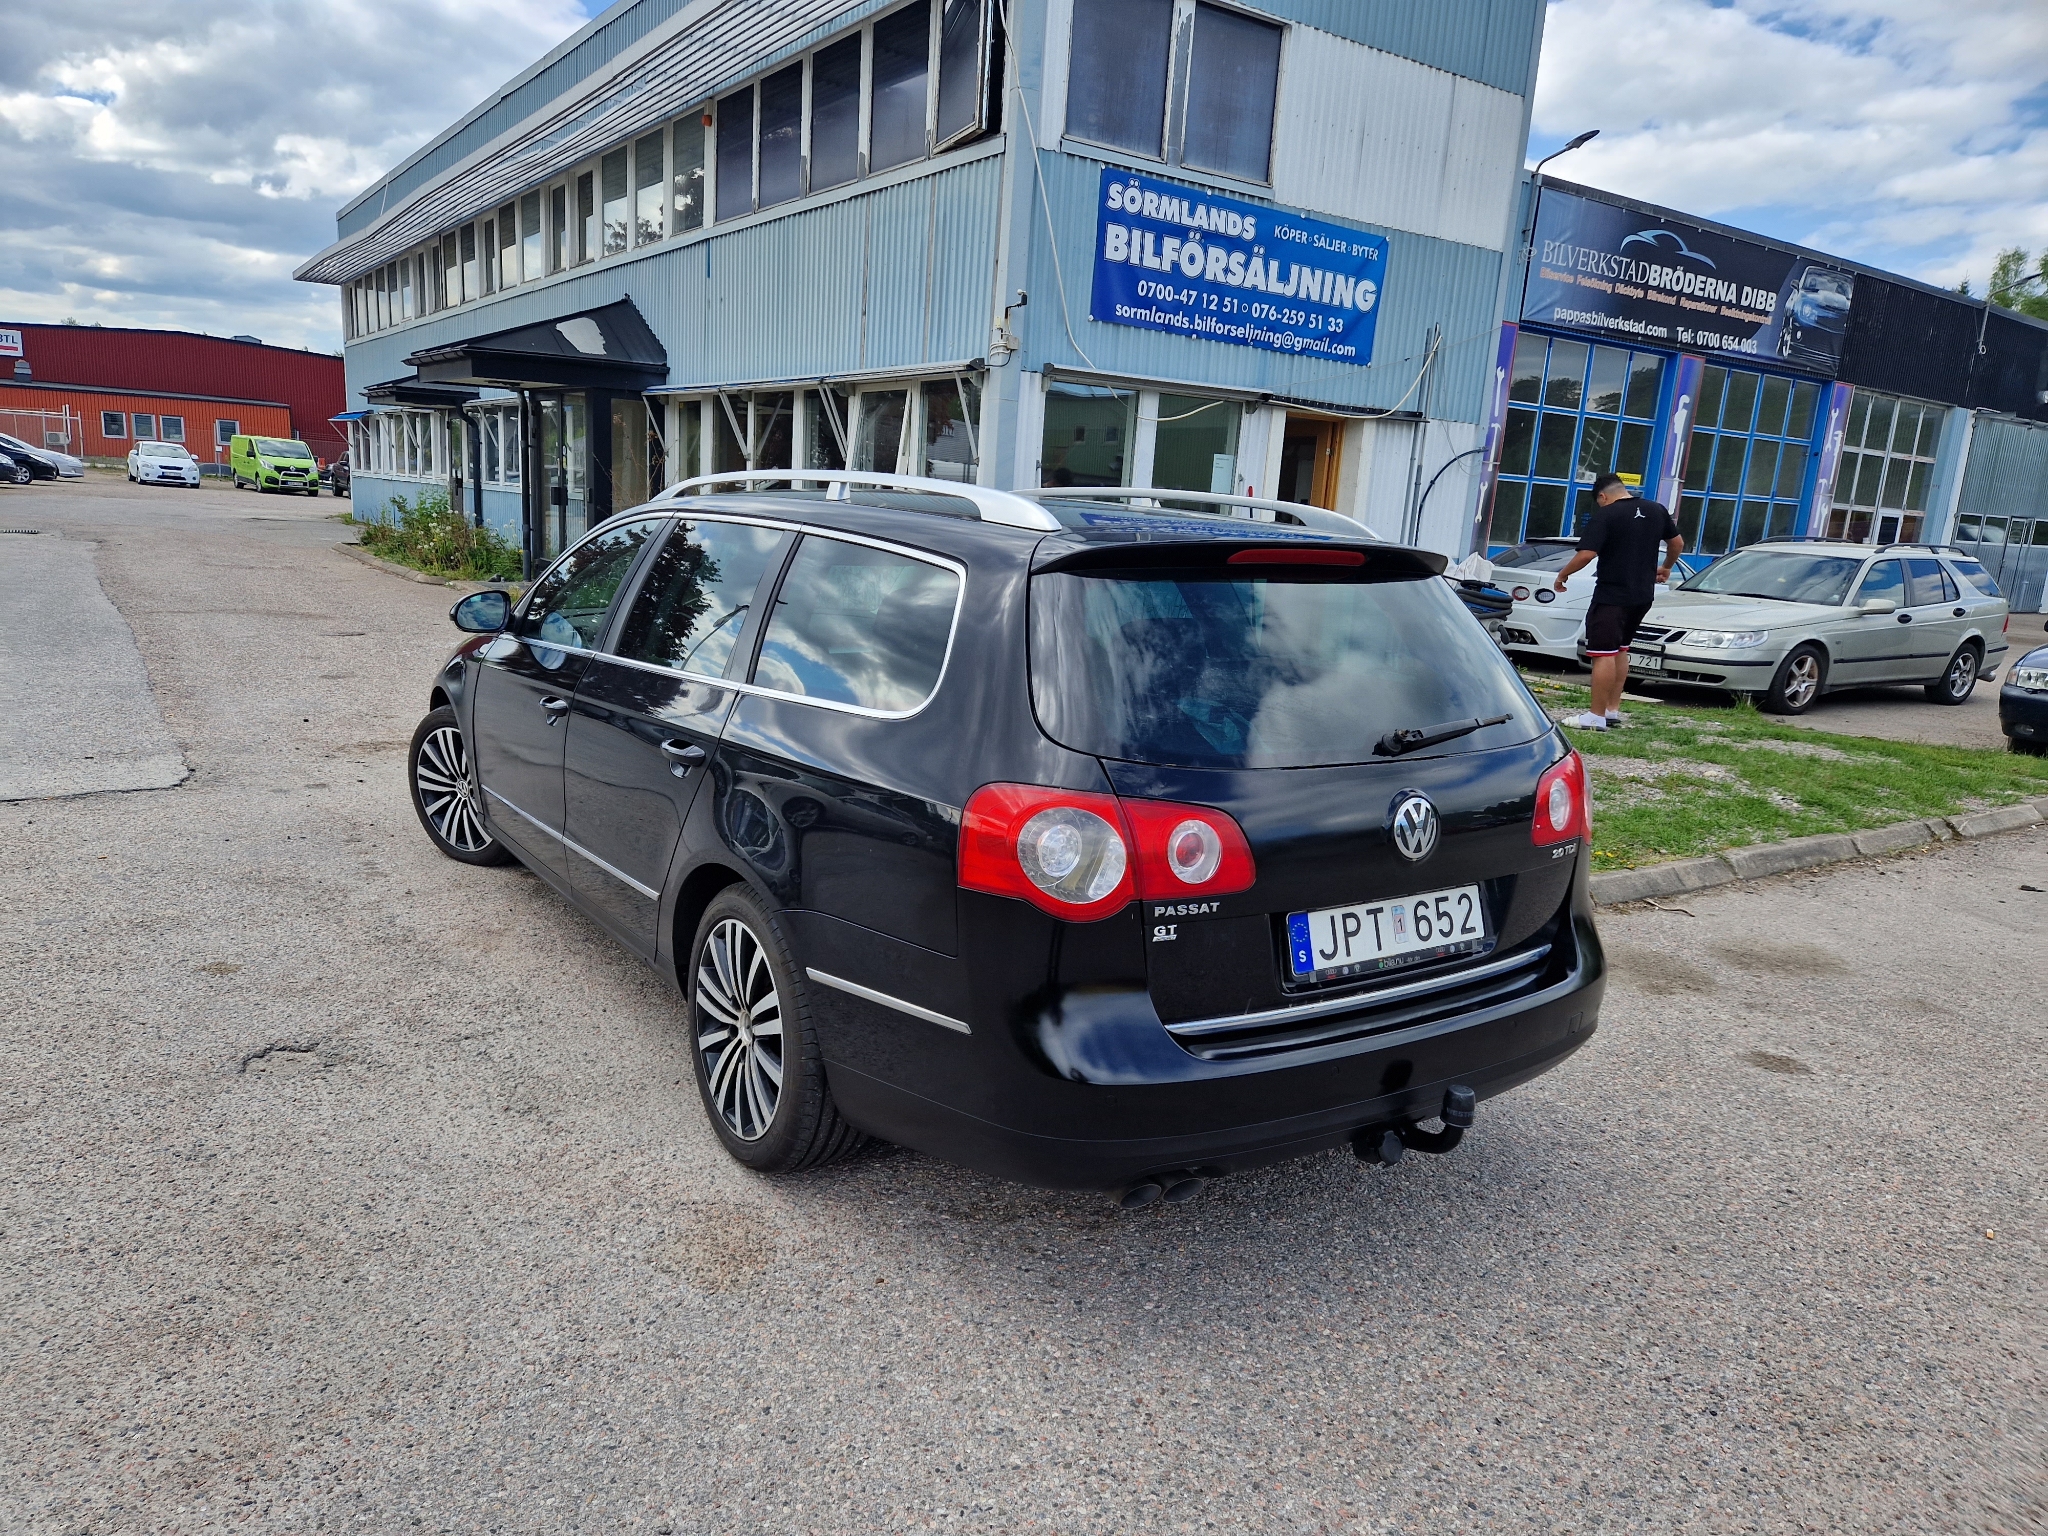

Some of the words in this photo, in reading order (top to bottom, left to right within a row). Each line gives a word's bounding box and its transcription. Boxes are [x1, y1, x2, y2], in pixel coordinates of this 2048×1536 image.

[1106, 178, 1257, 241] SÖRMLANDS
[1274, 224, 1308, 244] KÖPER
[1313, 233, 1346, 253] SÄLJER
[1351, 243, 1379, 261] BYTER
[1104, 222, 1378, 313] BILFÖRSÄLJNING
[1137, 279, 1198, 306] 0700-47
[1202, 292, 1219, 310] 12
[1222, 296, 1238, 313] 51
[1251, 302, 1306, 326] 076-259
[1308, 313, 1323, 330] 51
[1327, 316, 1344, 333] 33
[1740, 286, 1777, 312] DIBB
[1553, 306, 1668, 338] pappasbilverkstad.com
[1677, 326, 1695, 344] Tel:
[1696, 330, 1720, 349] 0700
[1721, 335, 1740, 351] 654
[1740, 338, 1757, 355] 003
[1638, 655, 1658, 668] 721
[1153, 924, 1177, 936] GT
[1154, 902, 1220, 917] PASSAT
[1298, 950, 1307, 963] S
[1318, 907, 1384, 961] JPT
[1413, 892, 1477, 942] 652
